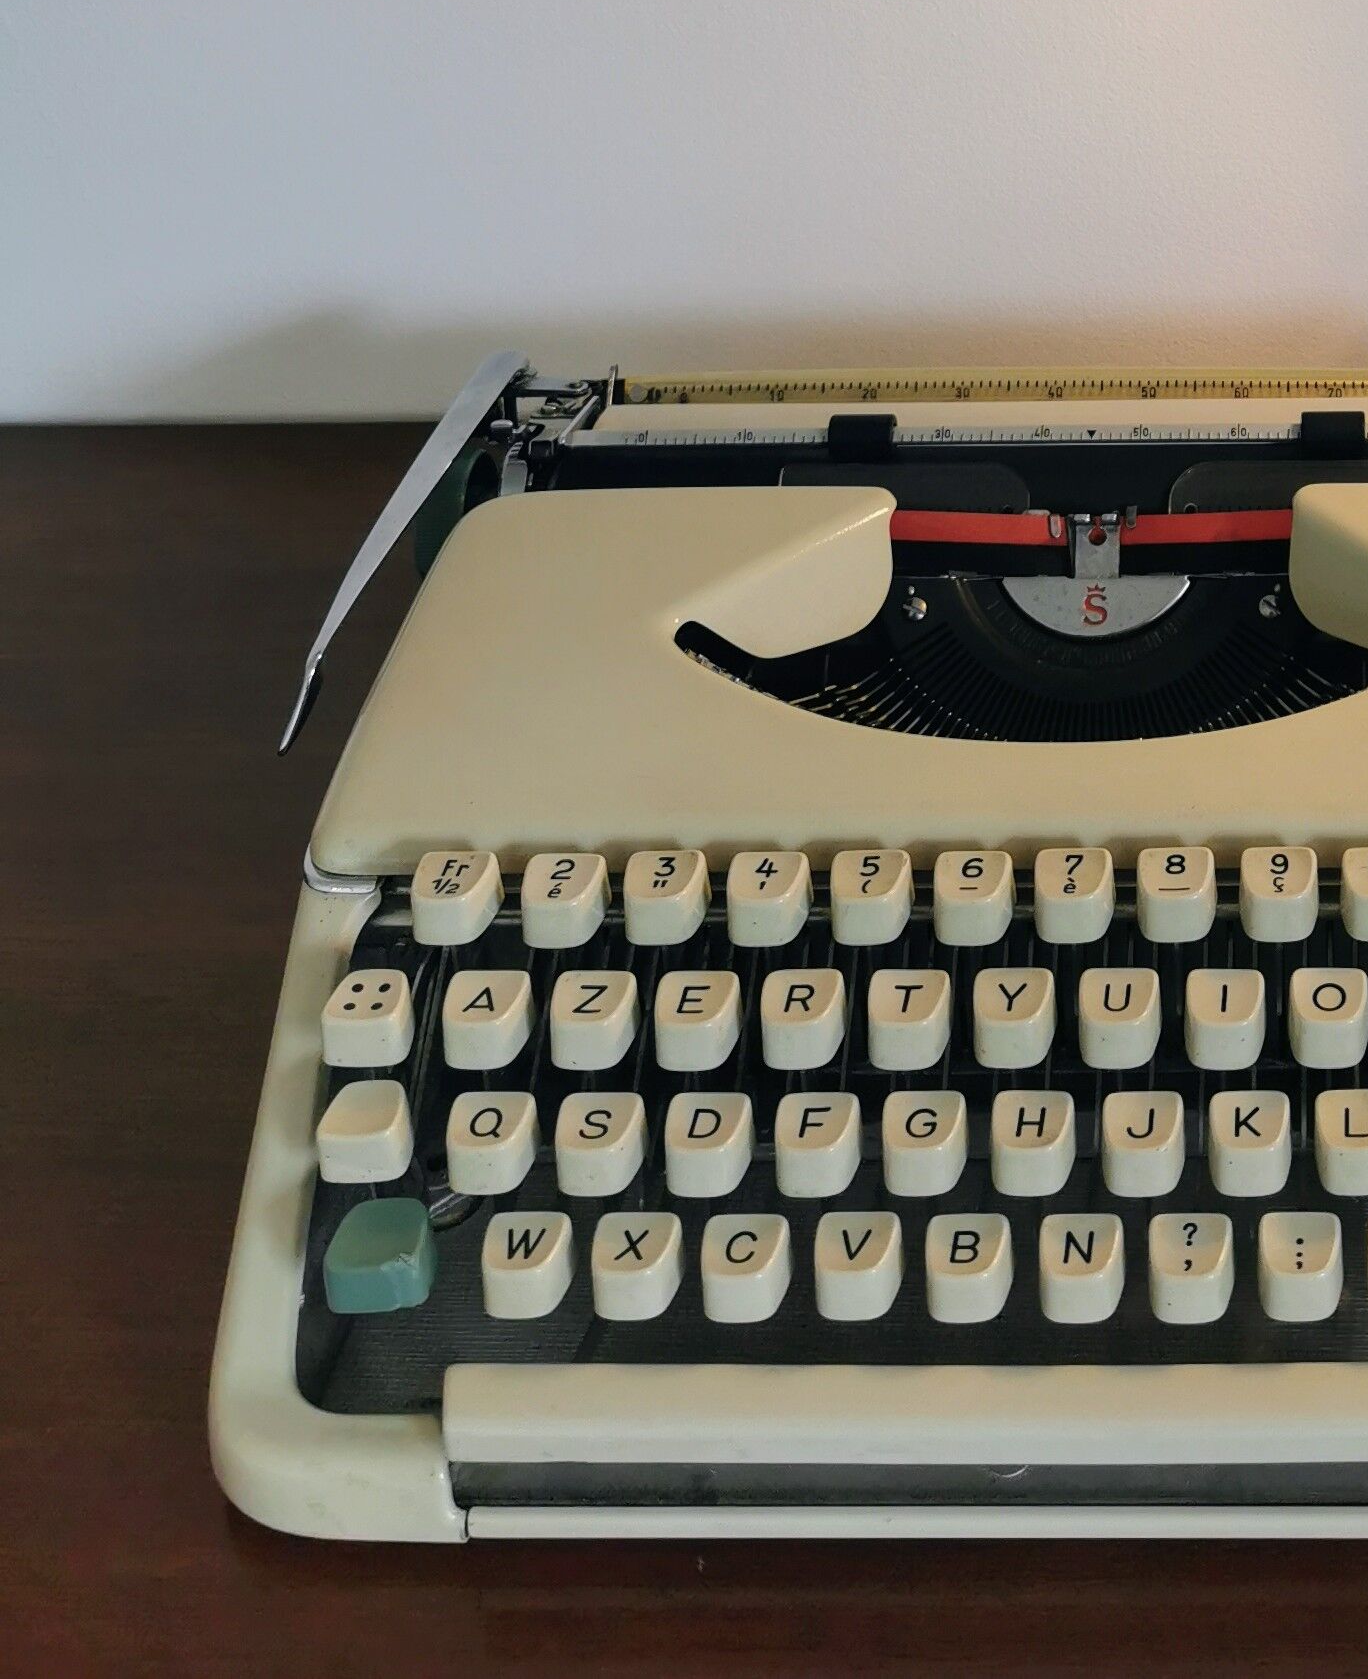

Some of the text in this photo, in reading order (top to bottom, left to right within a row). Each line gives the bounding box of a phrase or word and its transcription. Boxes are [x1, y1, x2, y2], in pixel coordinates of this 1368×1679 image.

[860, 388, 878, 400] 20
[955, 387, 971, 399] 30
[1048, 386, 1064, 399] 40
[1140, 386, 1158, 399] 50
[1233, 386, 1250, 398] 60
[1327, 387, 1343, 398] 70
[441, 859, 470, 877] Fr
[550, 858, 576, 880] 2
[653, 856, 676, 877] 3
[754, 857, 779, 878] 4
[859, 855, 881, 877] 5
[961, 857, 984, 879] 6
[1064, 854, 1084, 876] 7
[1165, 854, 1186, 875] 8
[1269, 853, 1289, 875] 9
[547, 882, 563, 899] é
[1062, 877, 1077, 894] è
[462, 986, 495, 1013] A
[571, 984, 609, 1014] Z
[676, 985, 711, 1014] E
[783, 984, 815, 1013] R
[894, 984, 924, 1013] T
[998, 982, 1028, 1012] Y
[1103, 983, 1132, 1012] U
[1220, 984, 1228, 1013] I
[1312, 982, 1347, 1012] O
[469, 1107, 503, 1139] Q
[578, 1109, 612, 1140] S
[687, 1108, 722, 1139] D
[798, 1106, 832, 1139] F
[905, 1108, 938, 1139] G
[1015, 1106, 1047, 1138] H
[1126, 1107, 1155, 1139] J
[1234, 1106, 1262, 1138] K
[507, 1228, 547, 1260] W
[614, 1229, 650, 1261] X
[725, 1230, 758, 1264] C
[842, 1228, 873, 1261] V
[949, 1230, 981, 1264] B
[1062, 1230, 1095, 1264] N
[1182, 1222, 1198, 1247] ?
